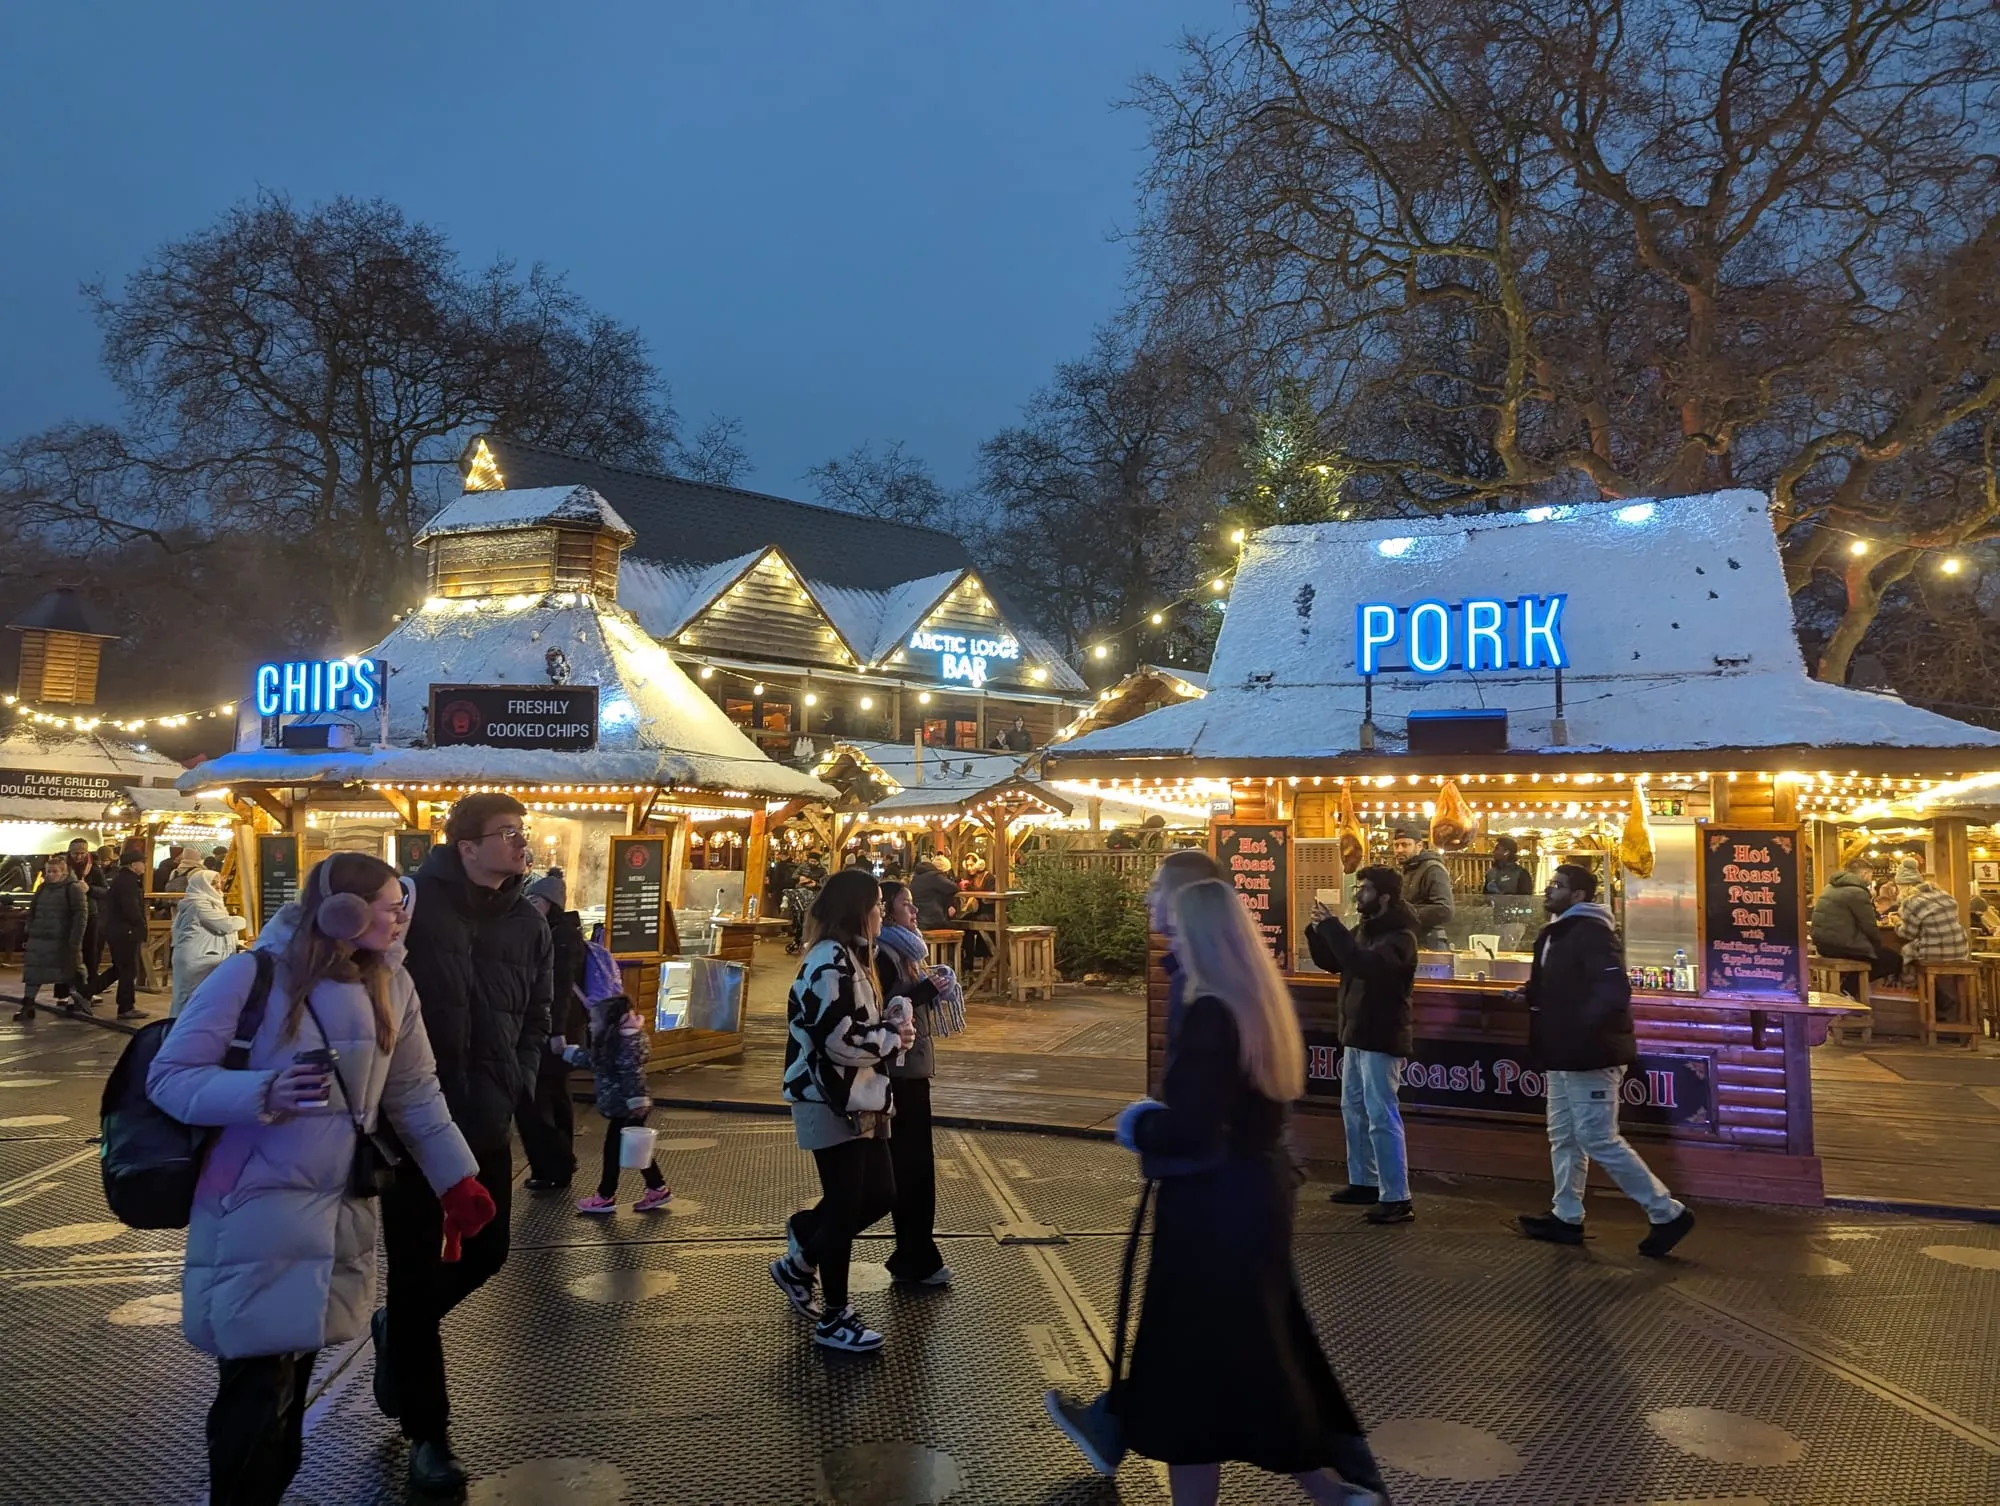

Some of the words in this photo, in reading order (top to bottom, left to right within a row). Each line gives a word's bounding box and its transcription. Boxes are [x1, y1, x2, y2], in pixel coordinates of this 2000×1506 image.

[1357, 594, 1570, 676] PORK
[909, 632, 966, 654] ARCTIC
[970, 638, 1019, 659] LODGE
[942, 653, 988, 682] BAR
[256, 658, 379, 716] CHIPS
[508, 700, 570, 715] FRESHLY
[486, 723, 545, 738] COOKED
[546, 723, 590, 738] CHIPS
[0, 784, 46, 796] DOUBLE
[24, 774, 62, 786] FLAME
[64, 776, 110, 788] GRILLED
[1238, 837, 1268, 854] Hot
[1732, 844, 1770, 863] Hot
[1230, 854, 1276, 872] Roast
[1234, 873, 1271, 890] Pork
[1722, 864, 1781, 884] Roast
[1728, 885, 1776, 905] Pork
[1731, 907, 1775, 928] Roll
[1740, 929, 1765, 941] with
[1721, 953, 1753, 966] Apple
[1617, 1070, 1678, 1109] oll
